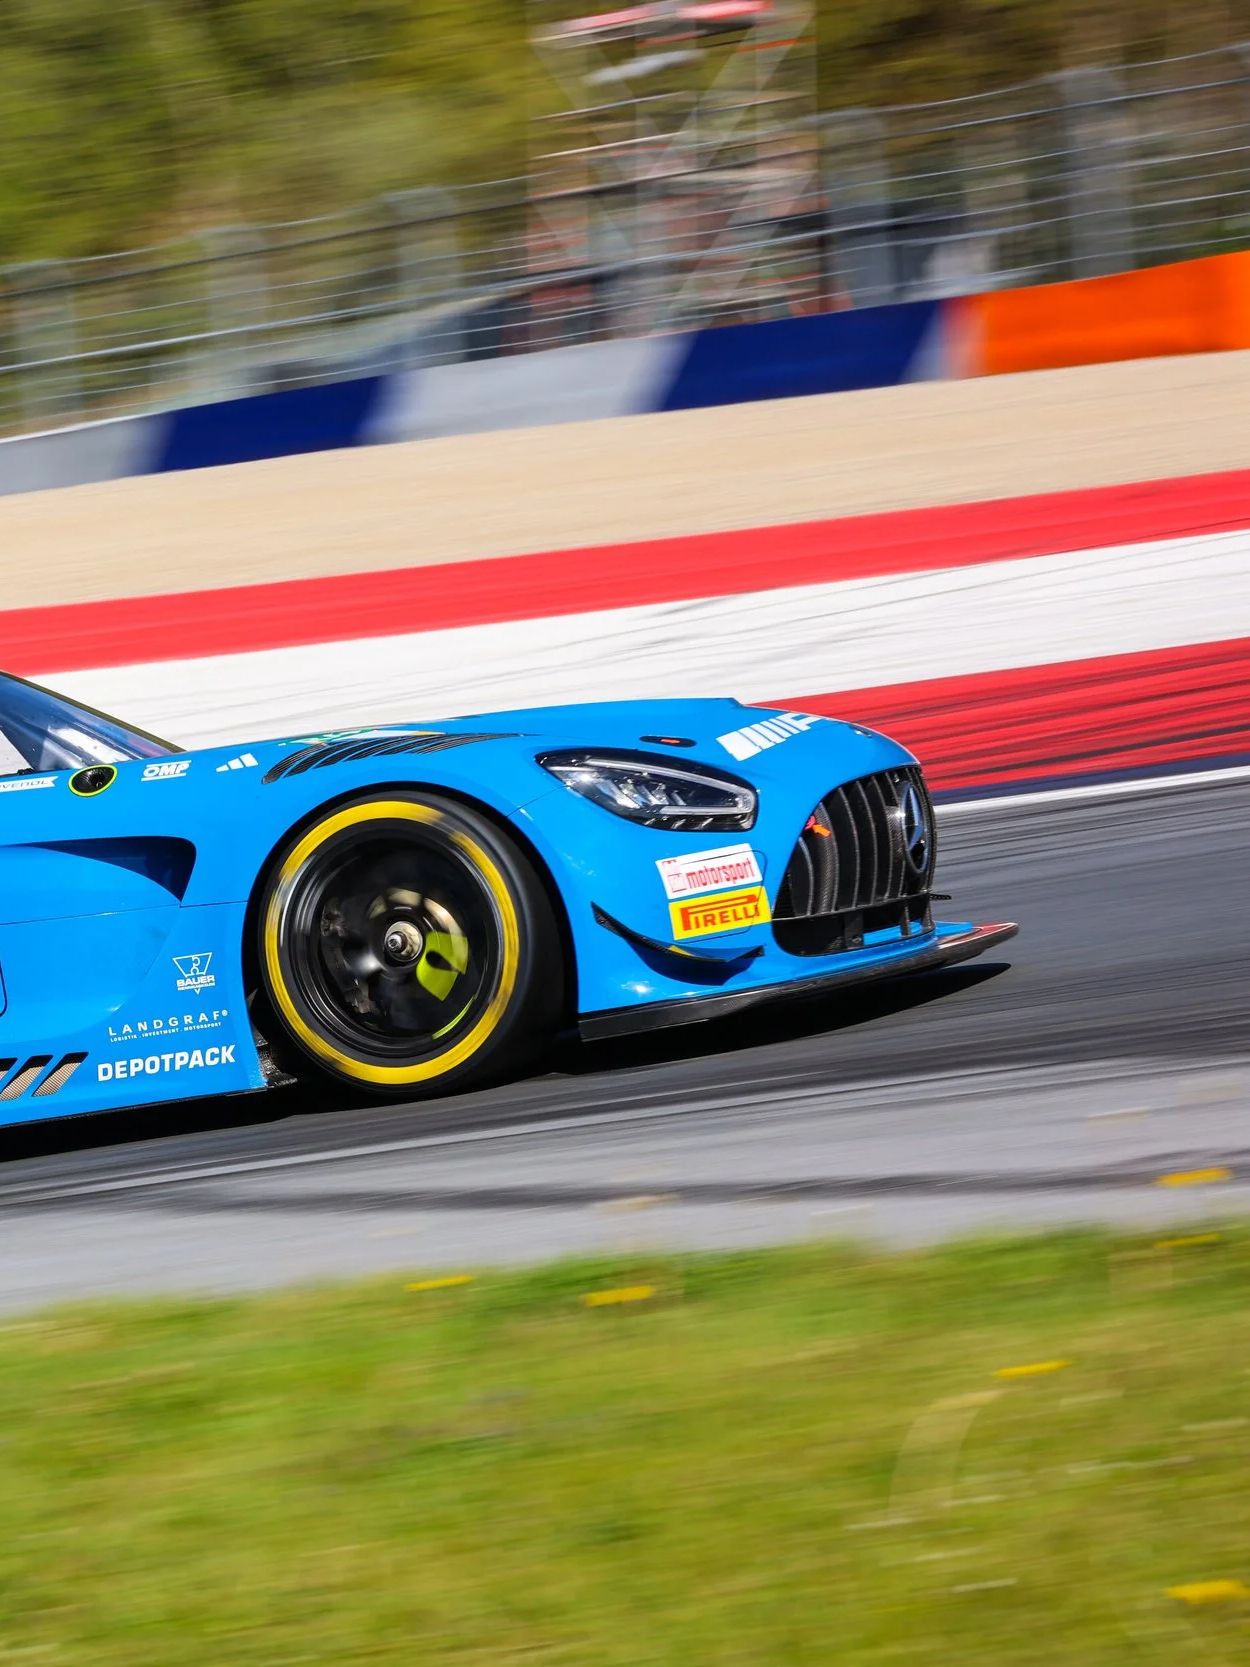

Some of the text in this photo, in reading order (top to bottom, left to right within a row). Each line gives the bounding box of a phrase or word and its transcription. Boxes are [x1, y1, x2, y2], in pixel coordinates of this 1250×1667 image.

[142, 762, 191, 778] OMP
[686, 858, 755, 889] motorsport
[680, 894, 761, 931] PIRELLI
[176, 974, 215, 987] BAUER
[110, 1022, 221, 1042] LOGISTIK INVESTMENT MOTORSPORT
[97, 1044, 235, 1082] DEPOTPACK
